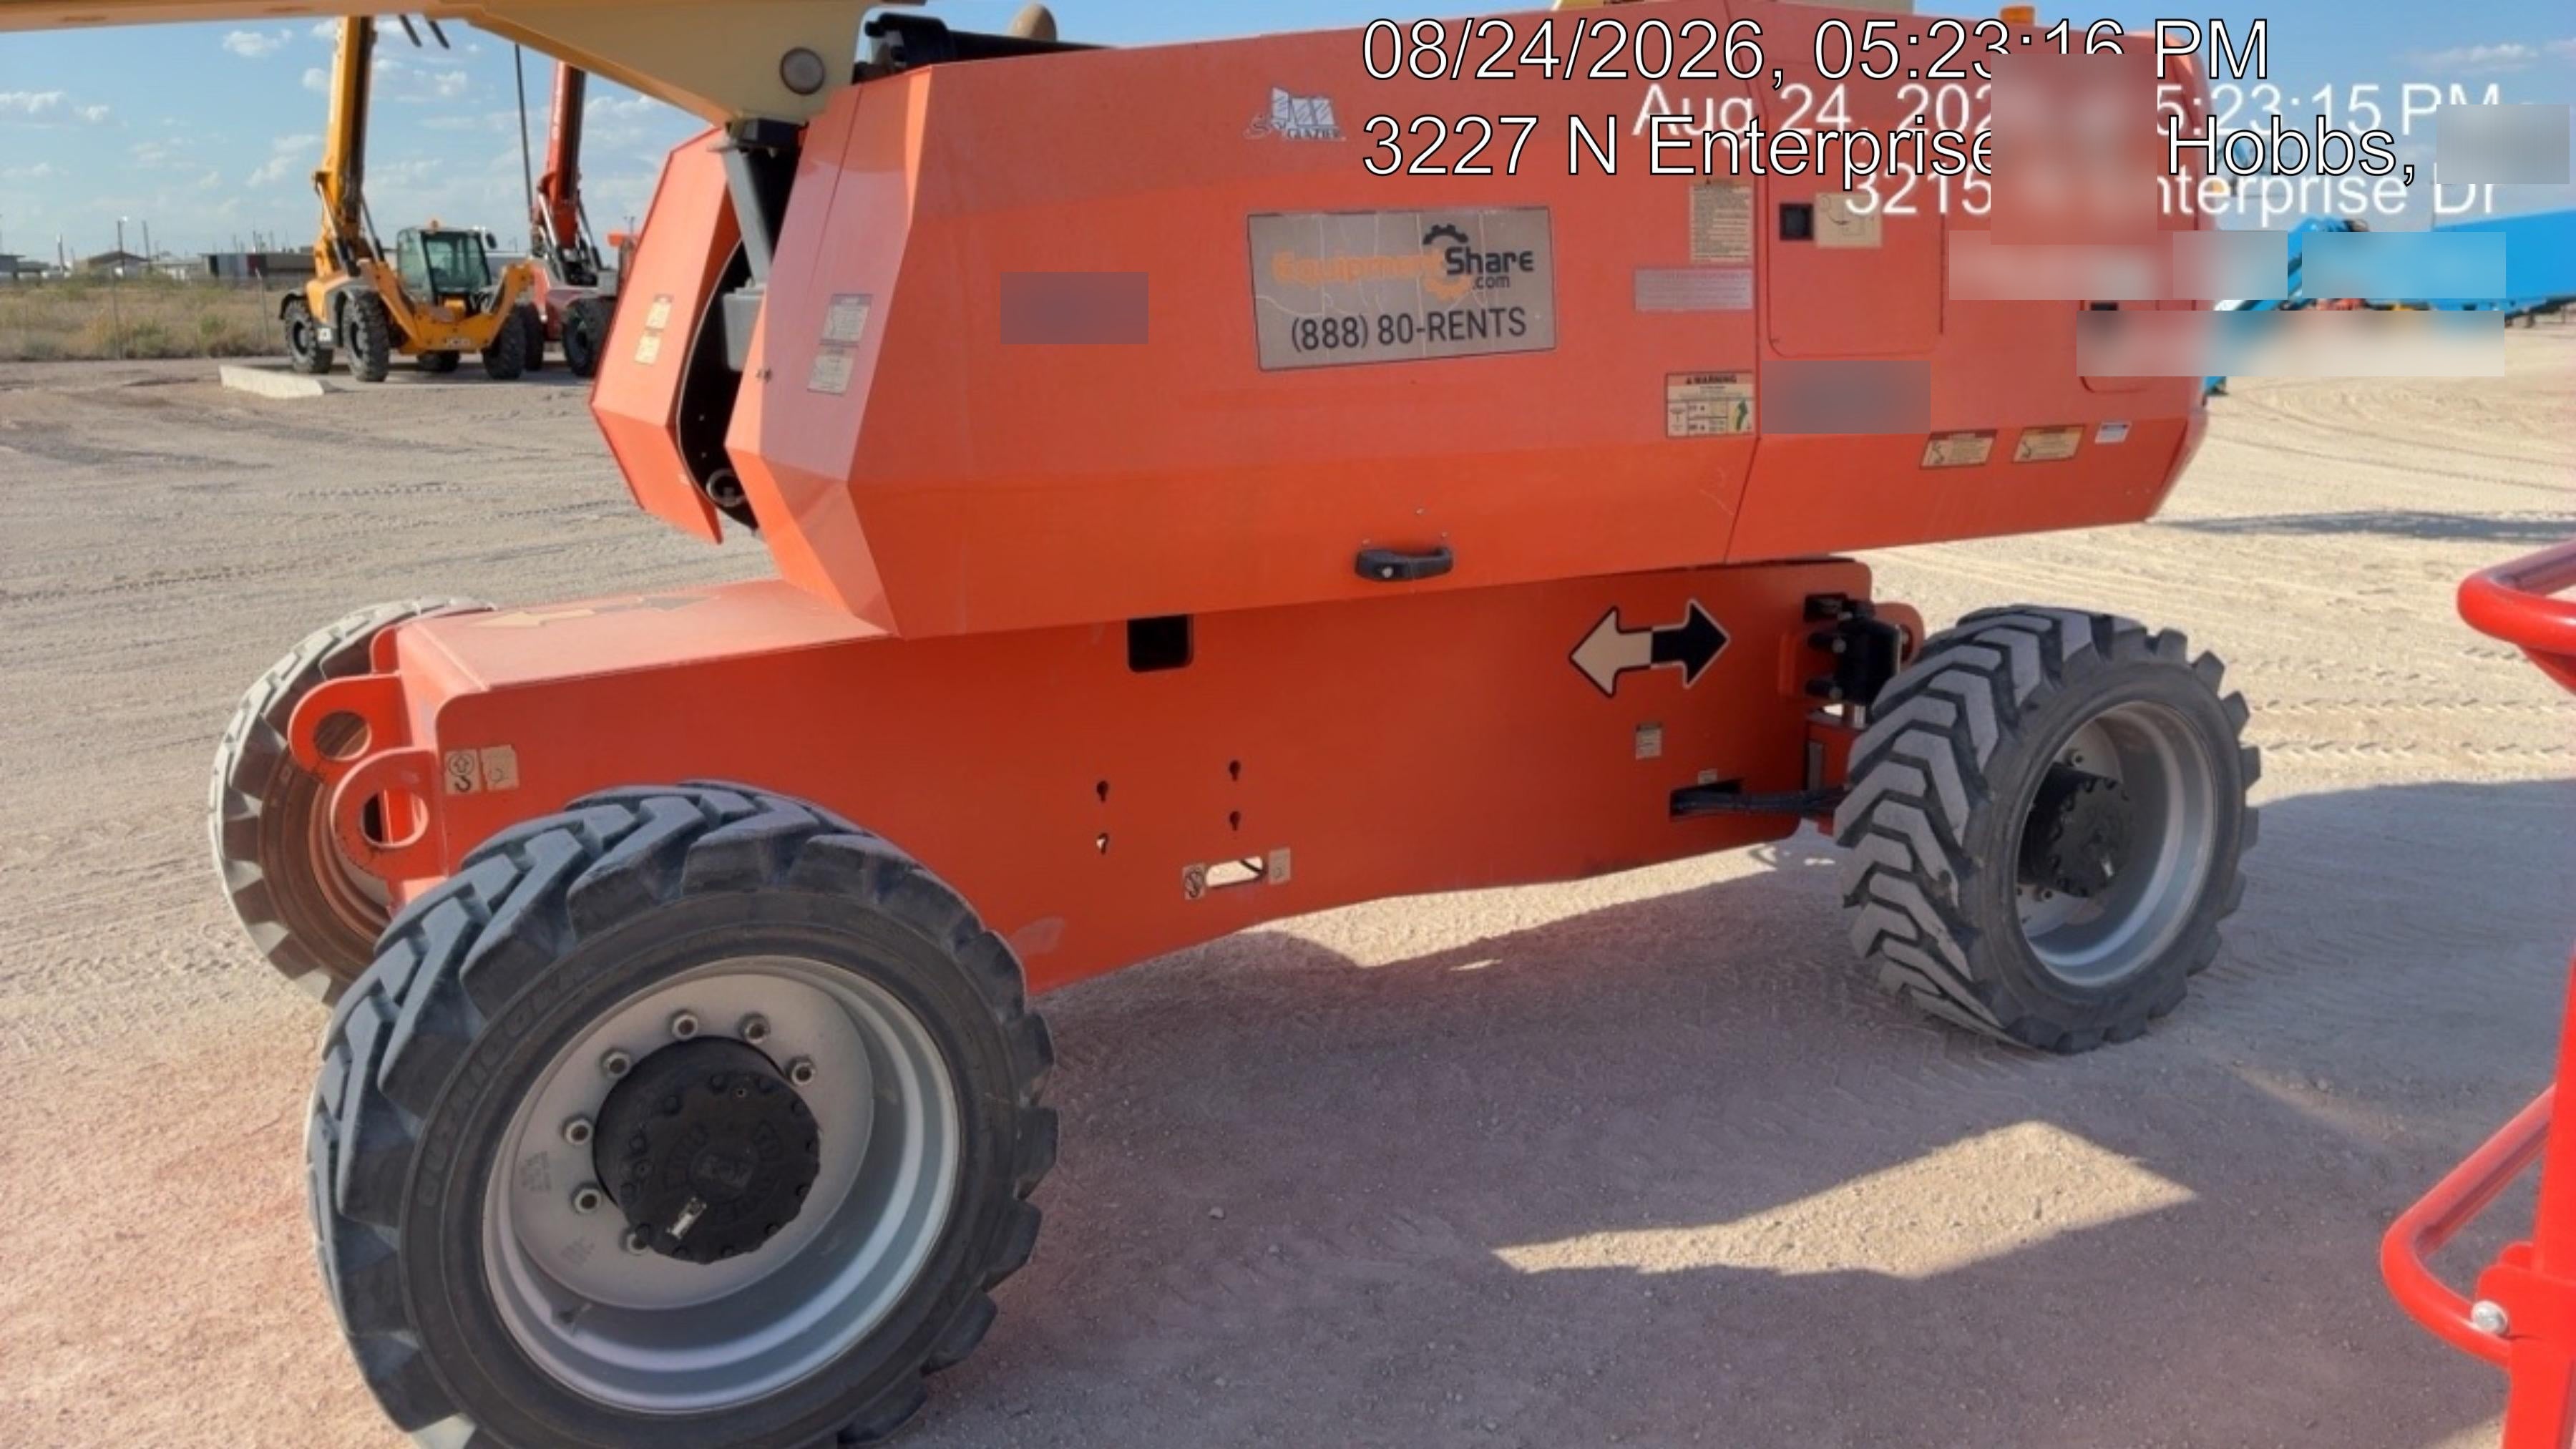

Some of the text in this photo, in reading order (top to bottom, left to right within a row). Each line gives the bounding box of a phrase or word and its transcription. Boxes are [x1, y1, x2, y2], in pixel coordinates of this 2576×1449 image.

[1473, 275, 1510, 290] .com
[1292, 307, 1527, 352] (888) 80-RENTS
